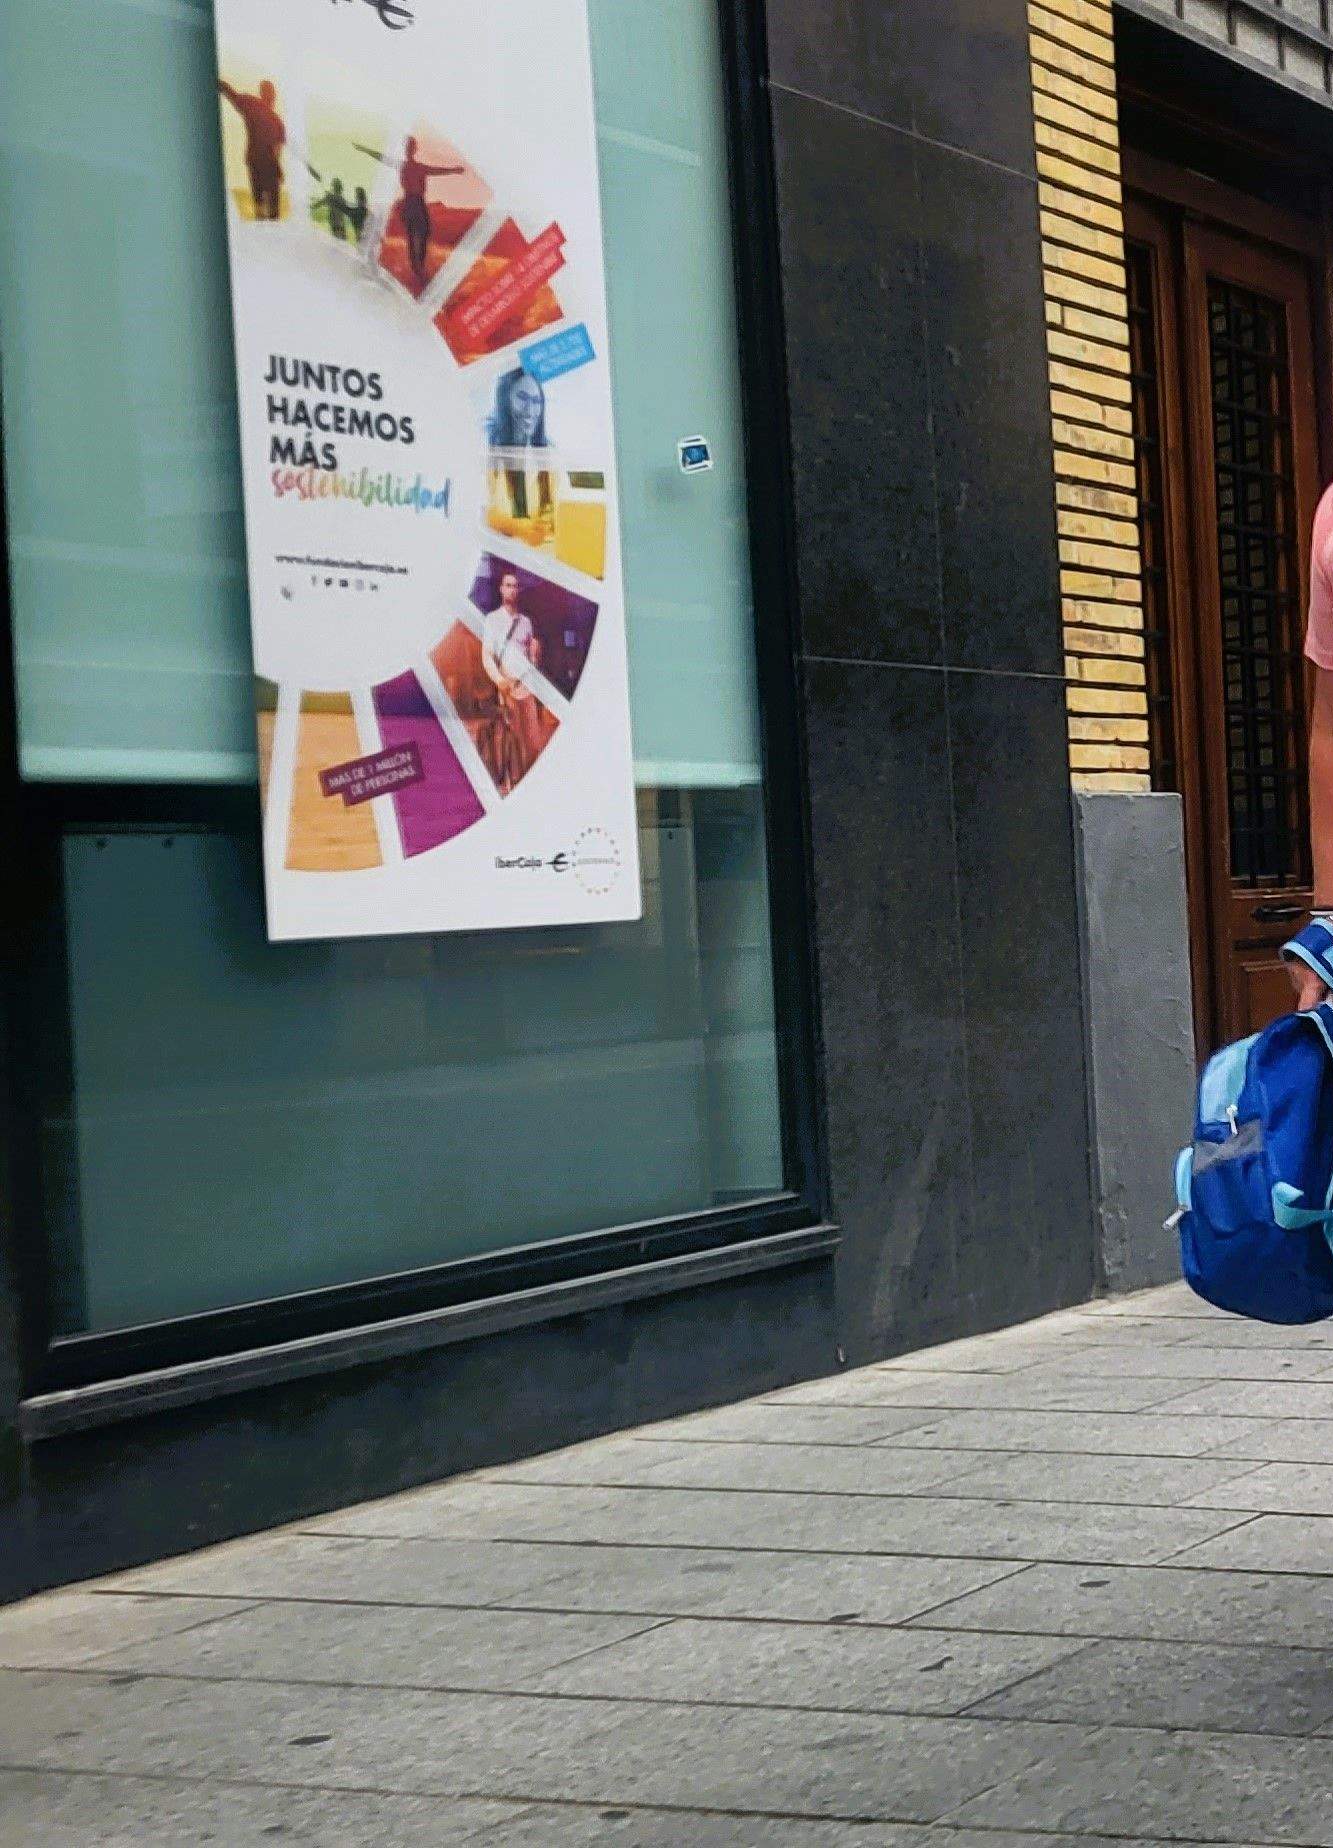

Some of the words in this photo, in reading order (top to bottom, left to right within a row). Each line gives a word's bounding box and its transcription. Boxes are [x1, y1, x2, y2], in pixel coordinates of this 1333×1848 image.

[264, 354, 383, 401] JUNTOS
[266, 394, 414, 445] HACEMOS
[269, 431, 337, 471] MÁS
[271, 467, 451, 518] sostenibilidad
